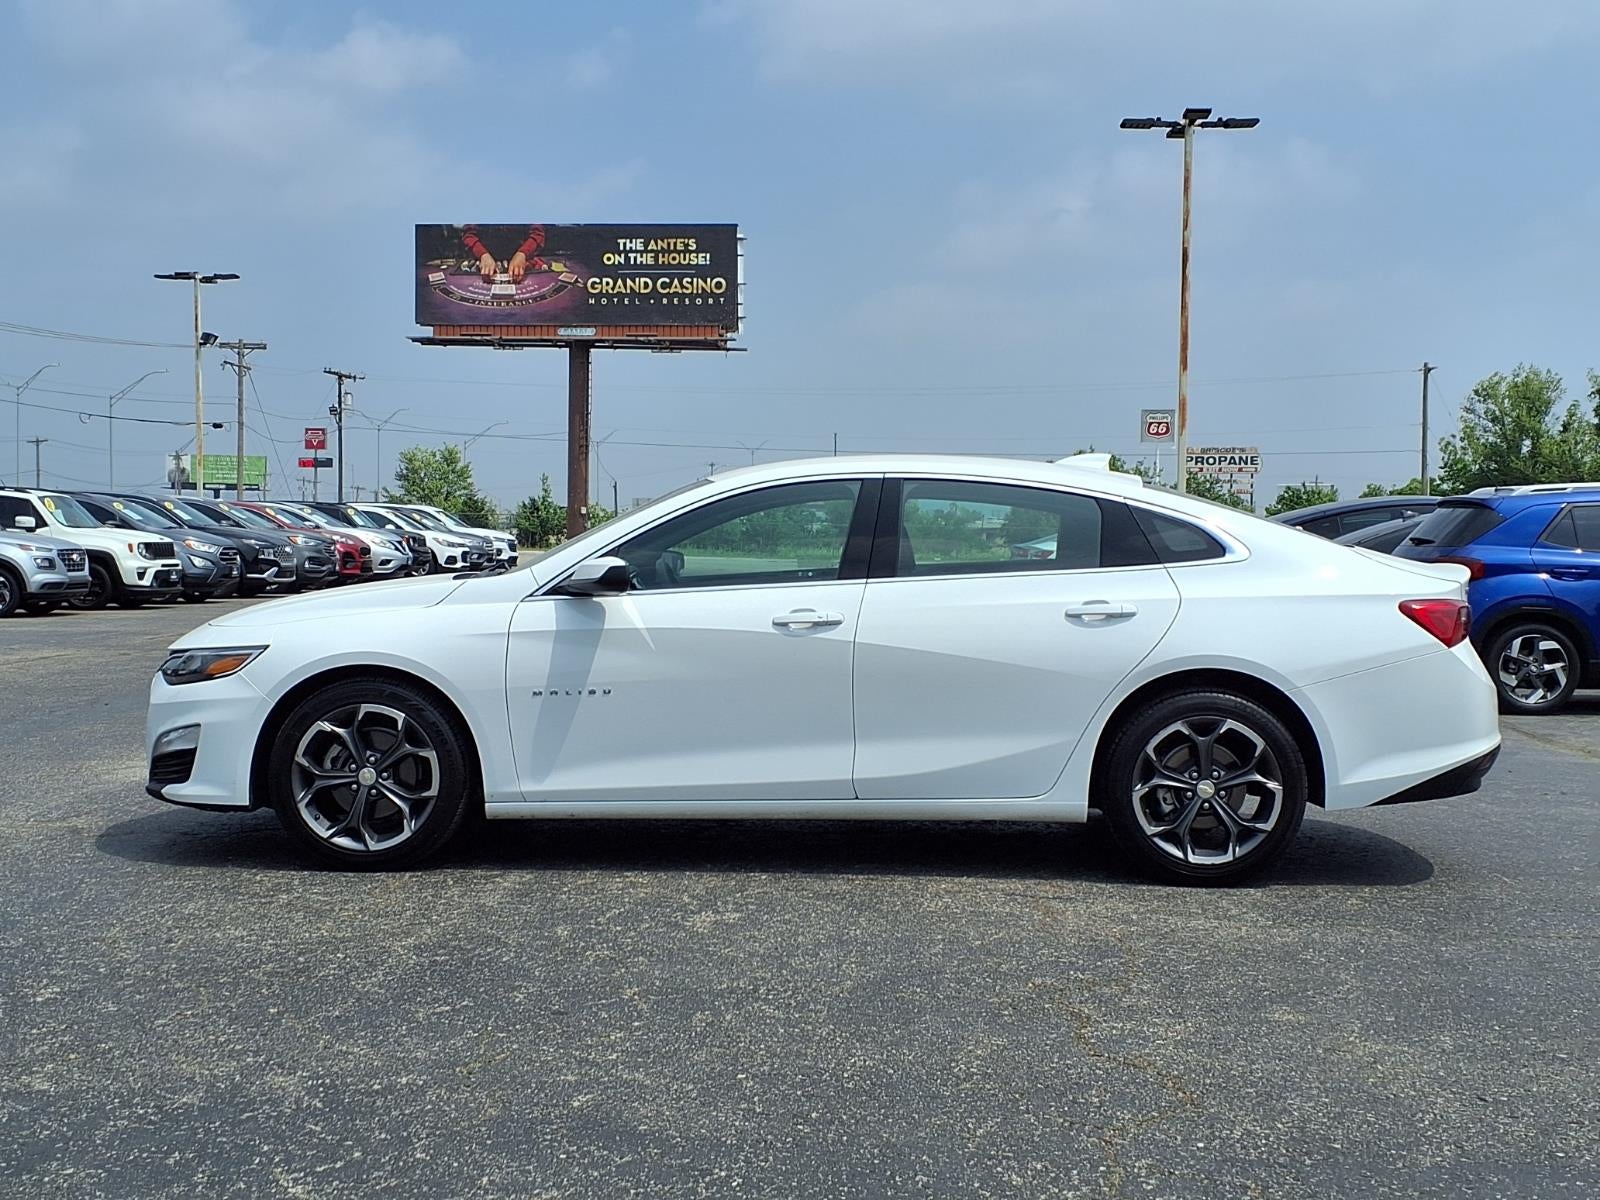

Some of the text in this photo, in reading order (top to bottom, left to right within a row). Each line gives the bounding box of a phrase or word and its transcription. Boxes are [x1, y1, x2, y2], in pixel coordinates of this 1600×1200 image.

[617, 238, 697, 251] THE ANTE'S
[603, 253, 711, 265] ON THE HOUSE!
[586, 277, 727, 294] GRAND CASINO
[588, 297, 726, 305] HOTEL RESORT
[1149, 423, 1168, 434] 66
[1186, 455, 1259, 466] PROPANE
[532, 689, 612, 697] MALIBU
